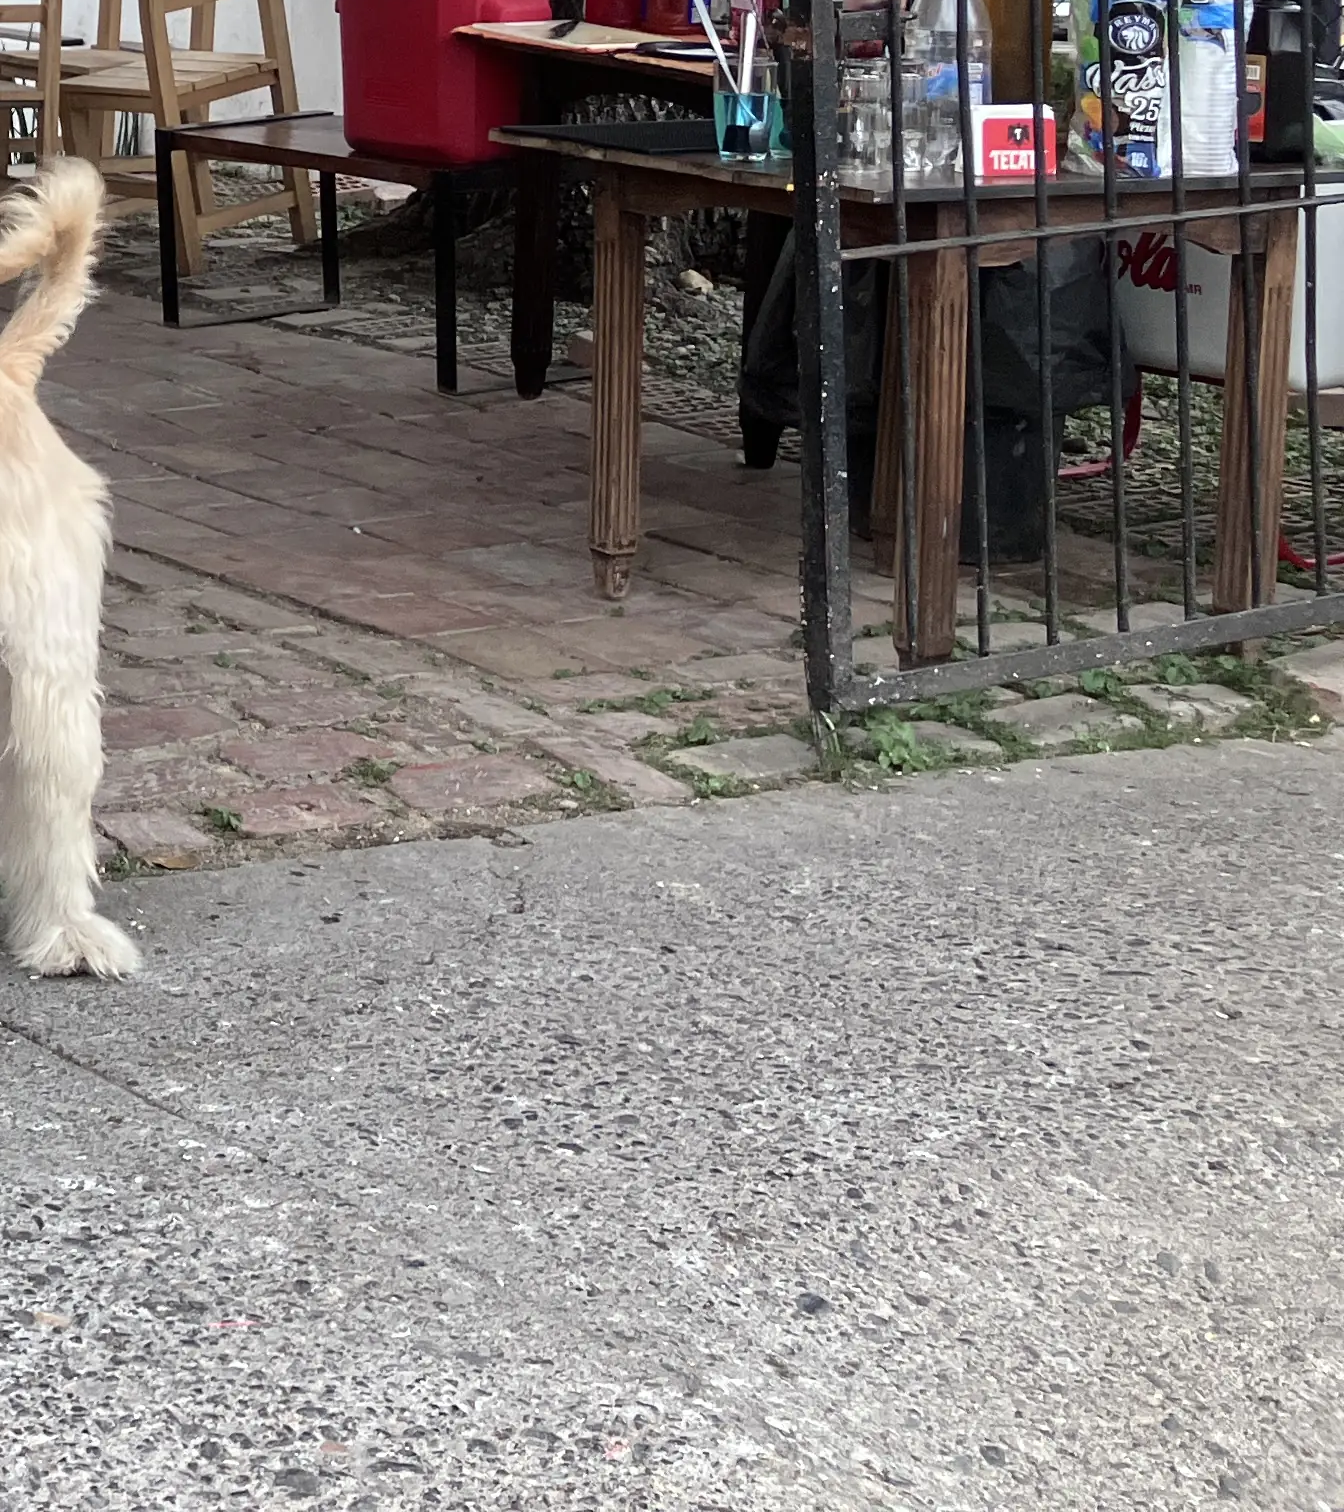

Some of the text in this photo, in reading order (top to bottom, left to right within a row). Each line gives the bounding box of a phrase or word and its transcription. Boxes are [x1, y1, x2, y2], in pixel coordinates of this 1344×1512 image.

[1113, 15, 1157, 31] REYMA
[1130, 96, 1161, 122] 25
[988, 149, 1042, 170] TECAT
